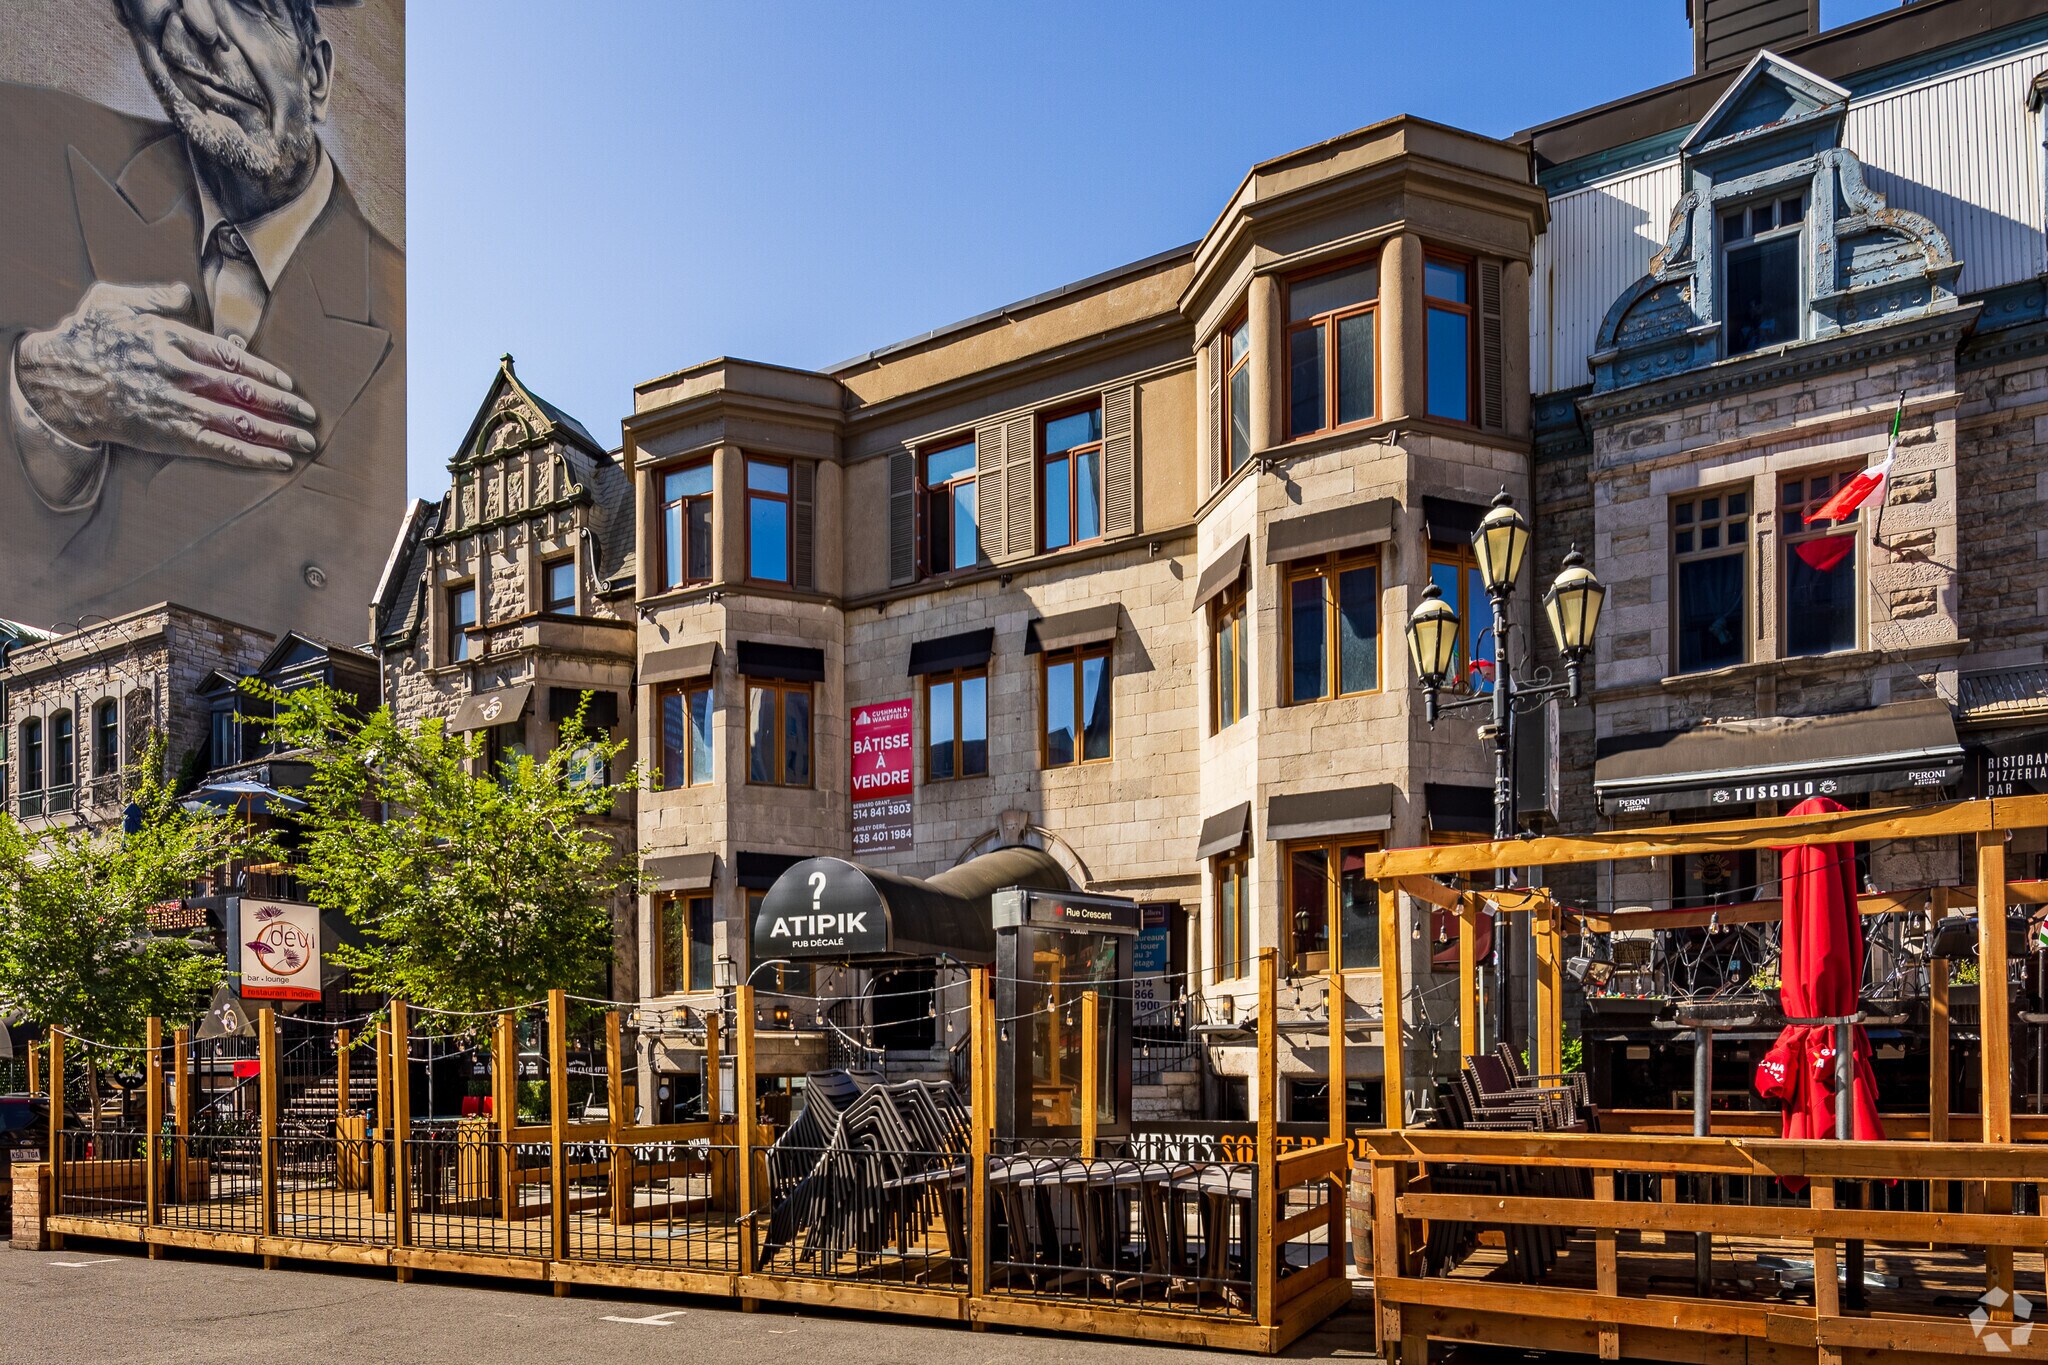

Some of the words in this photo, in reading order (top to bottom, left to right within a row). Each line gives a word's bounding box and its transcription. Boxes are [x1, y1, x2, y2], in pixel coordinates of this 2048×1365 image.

[872, 707, 902, 717] CUSHMAN
[872, 712, 908, 723] WAKEFIELD
[854, 733, 909, 754] BÂTISSE
[876, 752, 886, 769] À
[853, 769, 909, 789] VENDRE
[1909, 770, 1945, 780] PERONI
[1988, 766, 2047, 783] PIZZERIA
[1735, 781, 1813, 801] TUSCOLO
[1988, 783, 2012, 796] BAR
[853, 801, 874, 809] BERNARD
[1619, 798, 1650, 807] PERONI
[853, 809, 868, 819] 514
[870, 806, 885, 817] 841
[888, 803, 911, 815] 3803
[853, 824, 871, 833] ASHLEY
[853, 833, 870, 844] 438
[872, 831, 888, 842] 401
[890, 828, 912, 840] 1984
[1066, 907, 1080, 917] Rue
[1081, 908, 1112, 920] Crescent
[770, 912, 867, 938] ATIPIK
[270, 925, 315, 949] dévi
[792, 940, 808, 948] PUB
[810, 937, 844, 947] DÉCALÉ
[1140, 942, 1160, 950] louer
[1134, 951, 1143, 959] au
[1134, 959, 1155, 968] étage
[247, 974, 259, 982] bar
[265, 975, 290, 984] lounge
[1135, 979, 1152, 988] 514
[247, 989, 287, 998] restaurant
[291, 990, 314, 998] indien
[1135, 989, 1154, 999] 866
[1135, 1000, 1160, 1011] 1900
